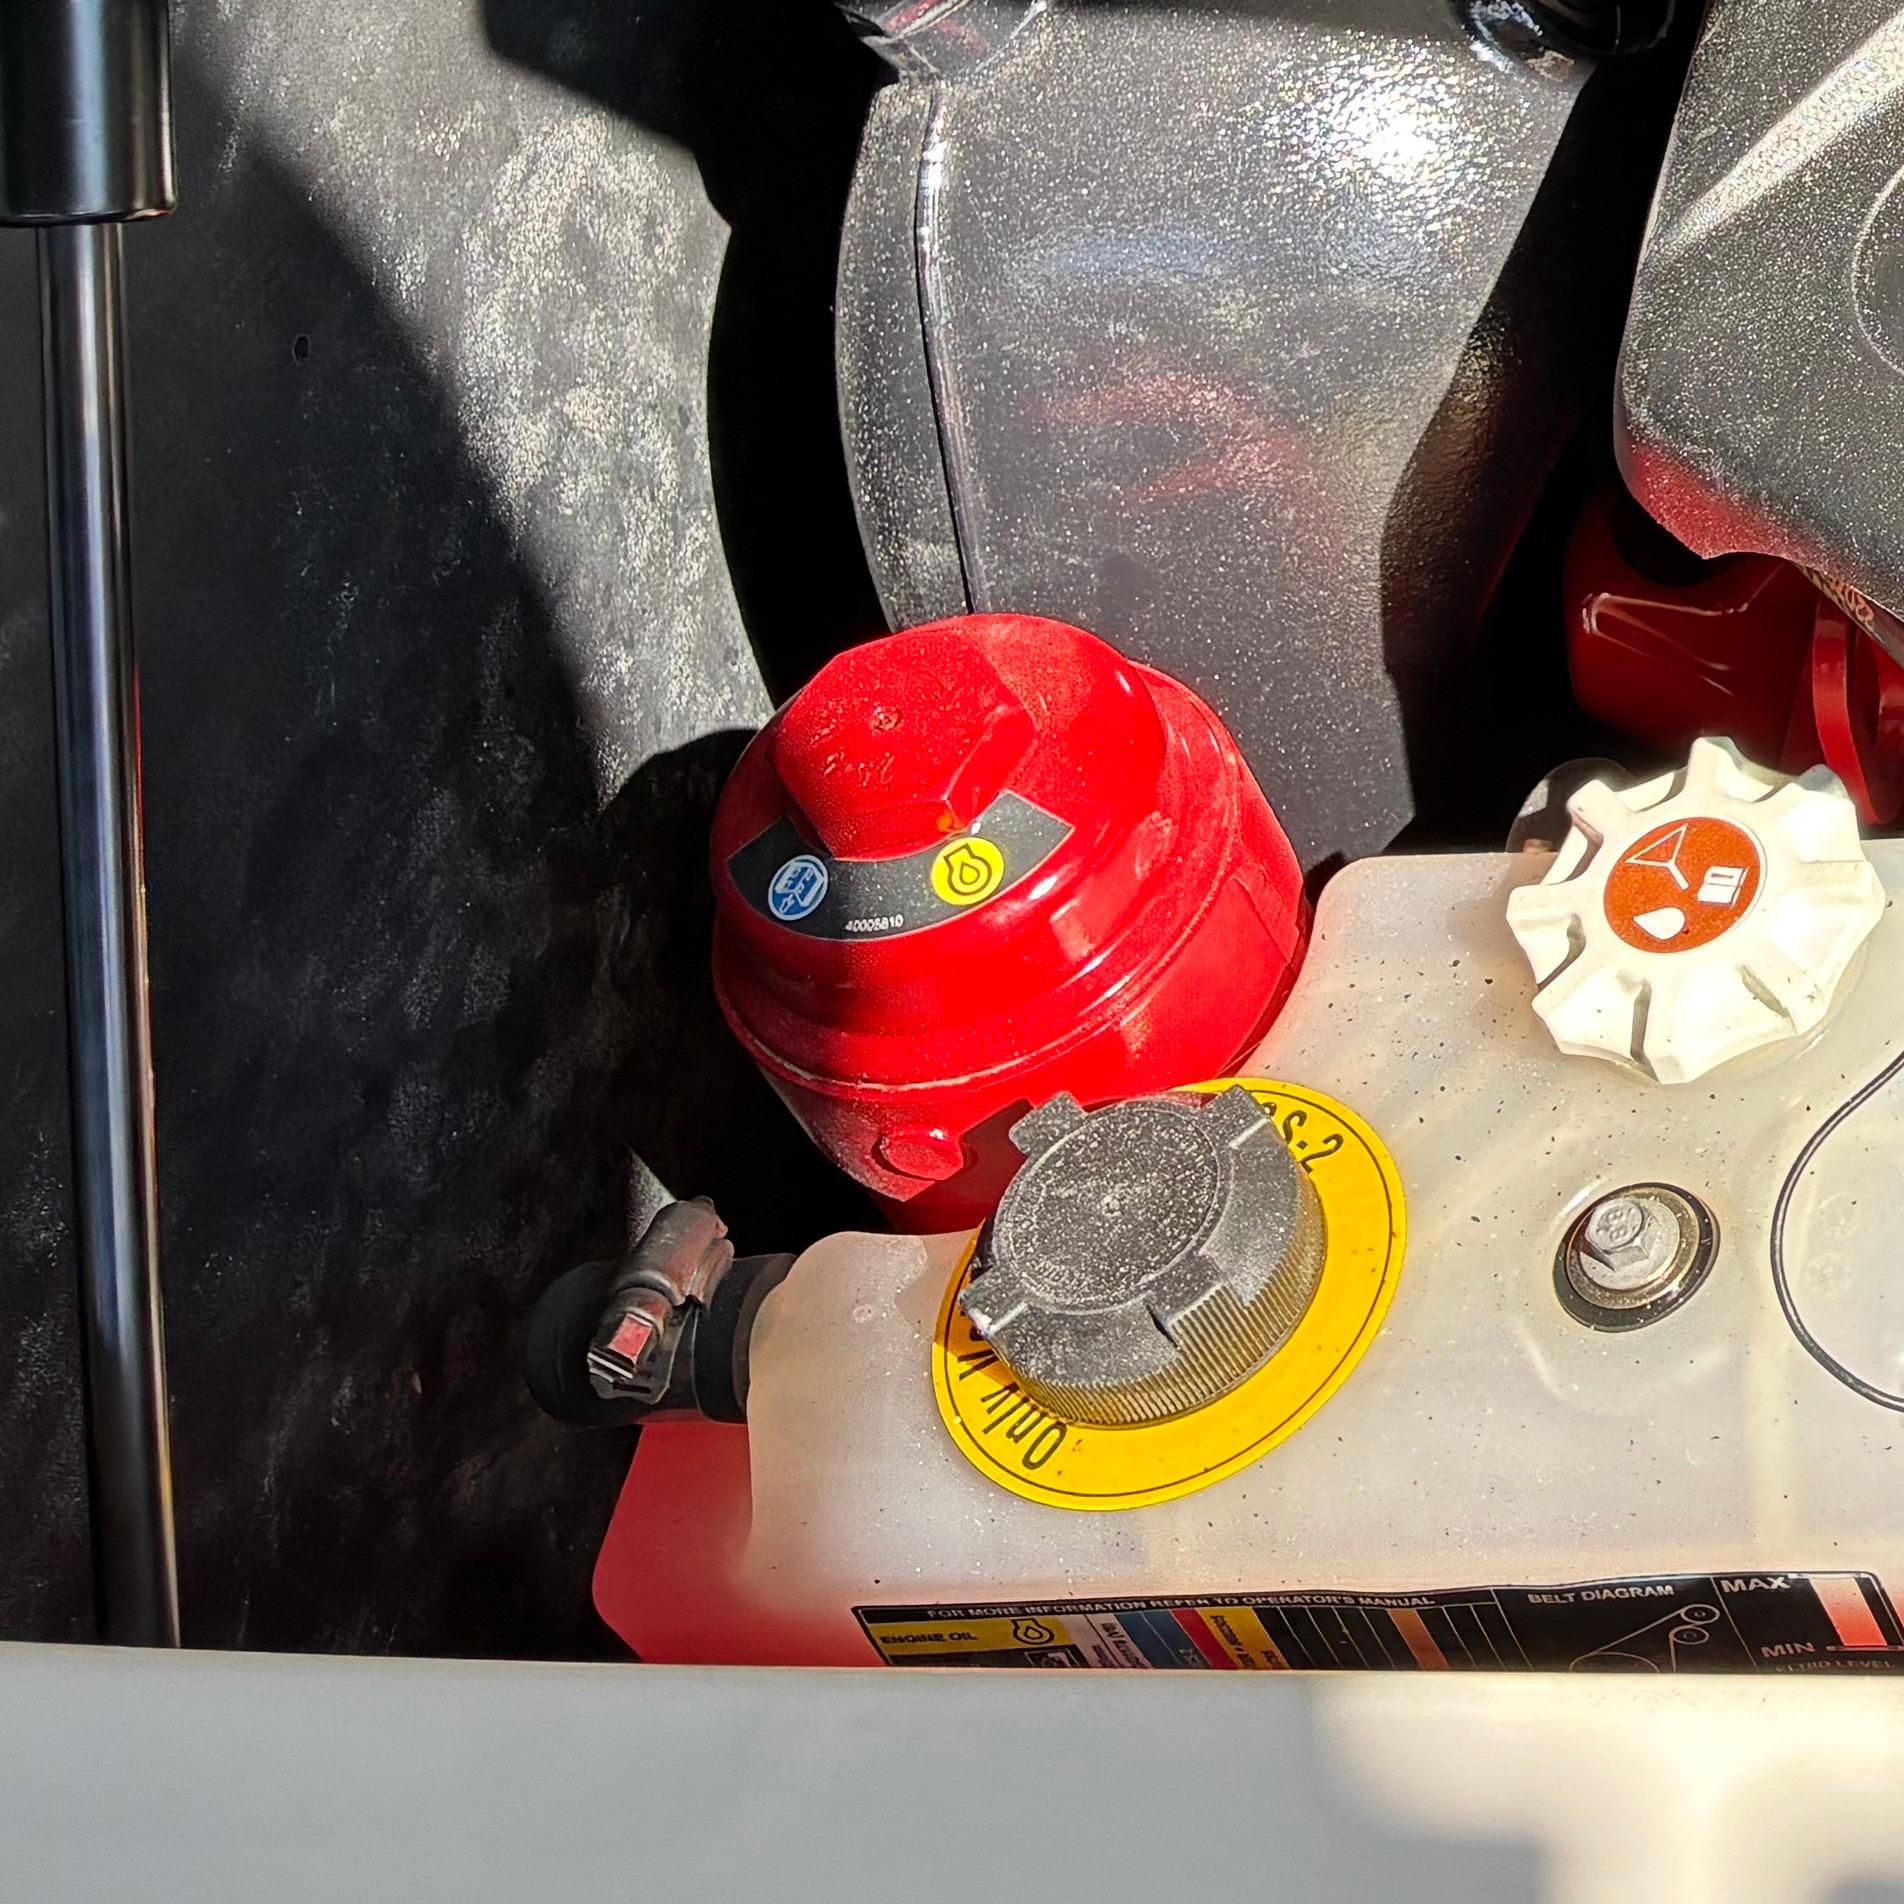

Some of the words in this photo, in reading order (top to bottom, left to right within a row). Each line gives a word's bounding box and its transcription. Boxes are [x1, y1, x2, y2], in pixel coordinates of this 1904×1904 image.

[979, 1382, 1067, 1470] Only
[1528, 1592, 1575, 1604] BELT
[1581, 1584, 1674, 1602] DIAGRAM
[1721, 1575, 1792, 1594] MAX
[927, 1607, 961, 1619] FOR
[968, 1606, 1018, 1617] MORE
[1024, 1601, 1137, 1617] INFORMATION
[1243, 1596, 1355, 1609] OPERATOR'S
[1358, 1595, 1435, 1607] MANUAL
[880, 1631, 945, 1645] ENGINE
[1761, 1642, 1816, 1658] MIN
[1836, 1659, 1894, 1669] LEVEL
